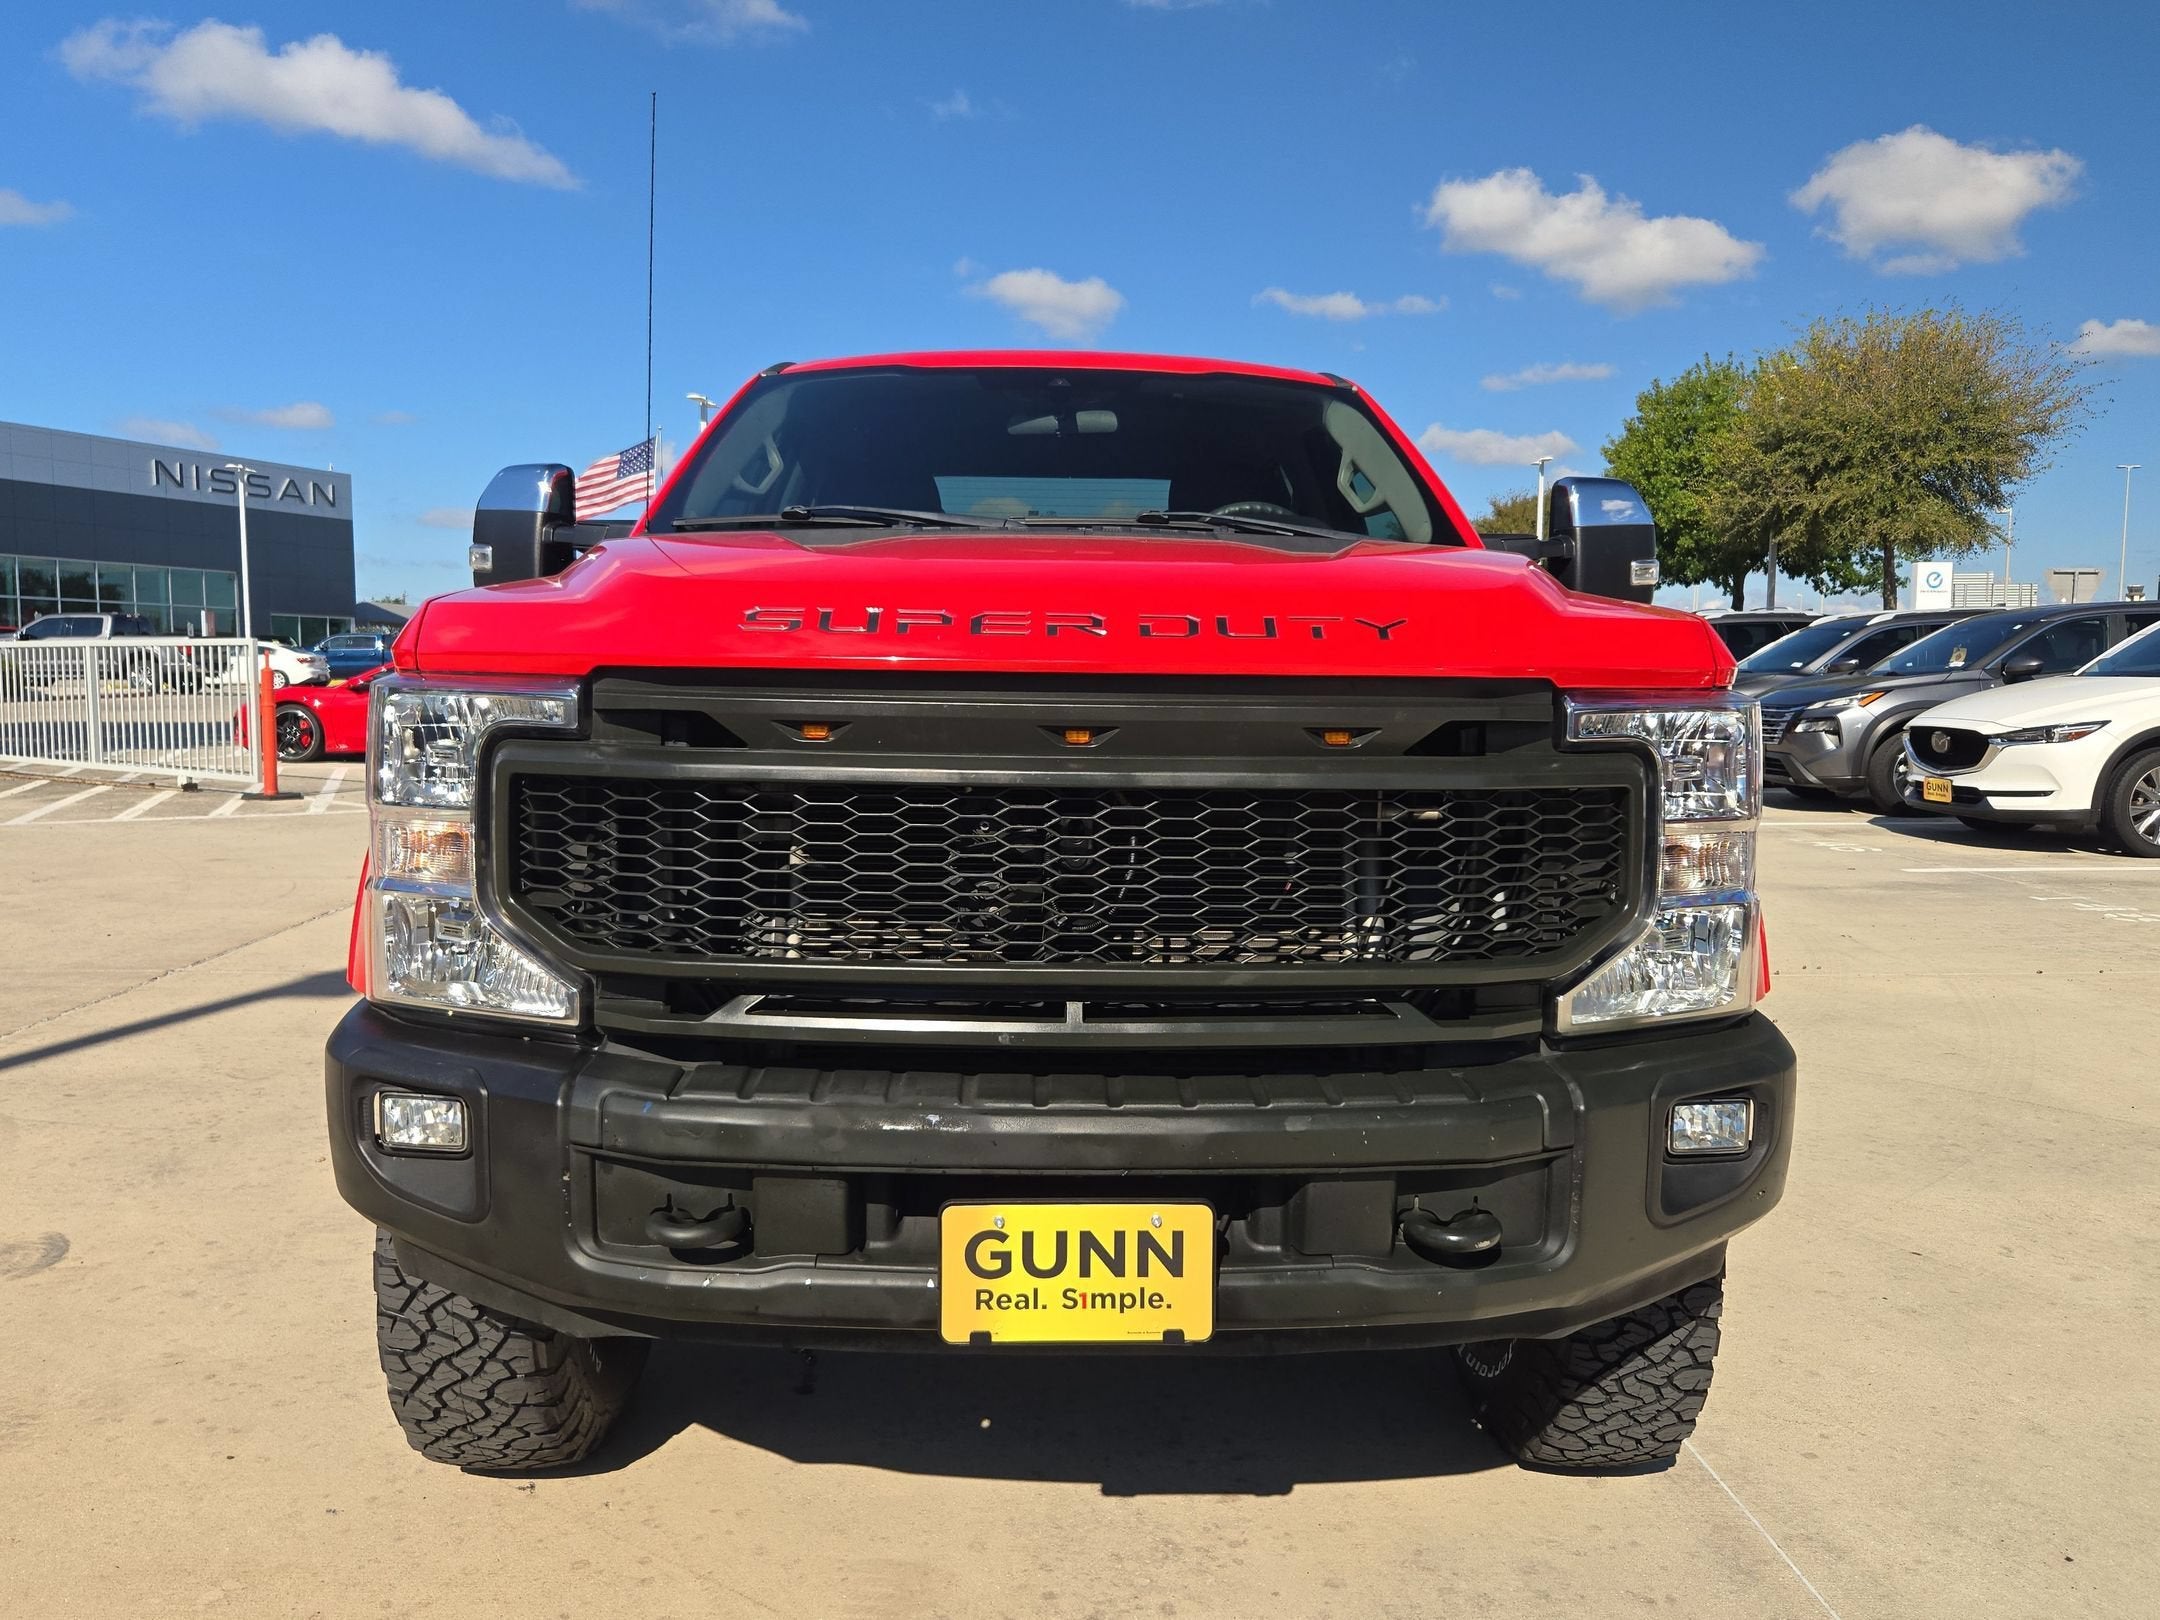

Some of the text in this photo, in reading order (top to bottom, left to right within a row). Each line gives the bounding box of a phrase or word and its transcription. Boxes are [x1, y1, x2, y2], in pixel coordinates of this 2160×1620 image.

[152, 458, 336, 508] NISSAN
[738, 605, 1409, 641] SUPER DUTY
[1926, 782, 1949, 792] GUNN
[964, 1229, 1184, 1279] GUNN
[975, 1288, 1048, 1310] Real.
